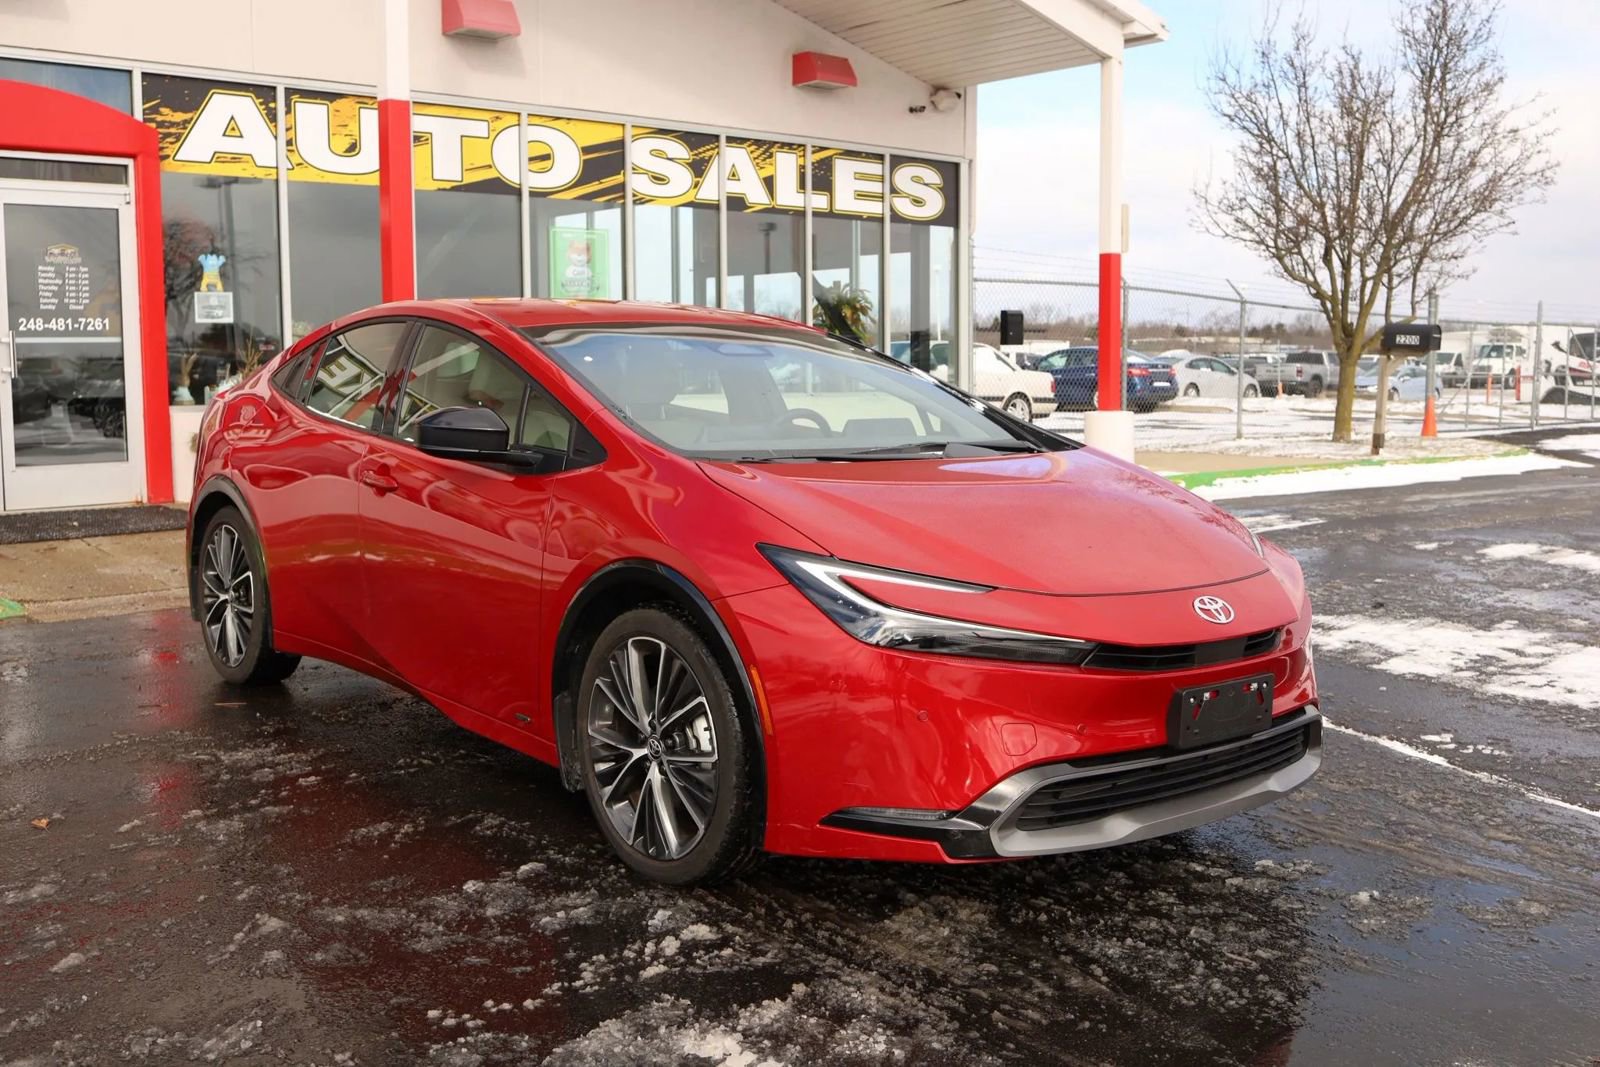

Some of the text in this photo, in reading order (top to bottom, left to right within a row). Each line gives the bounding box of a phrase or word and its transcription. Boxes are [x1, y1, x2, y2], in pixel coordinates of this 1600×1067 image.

[172, 89, 945, 221] AUTO SALES
[18, 317, 110, 331] 248-481-7261
[1397, 335, 1419, 344] 2200
